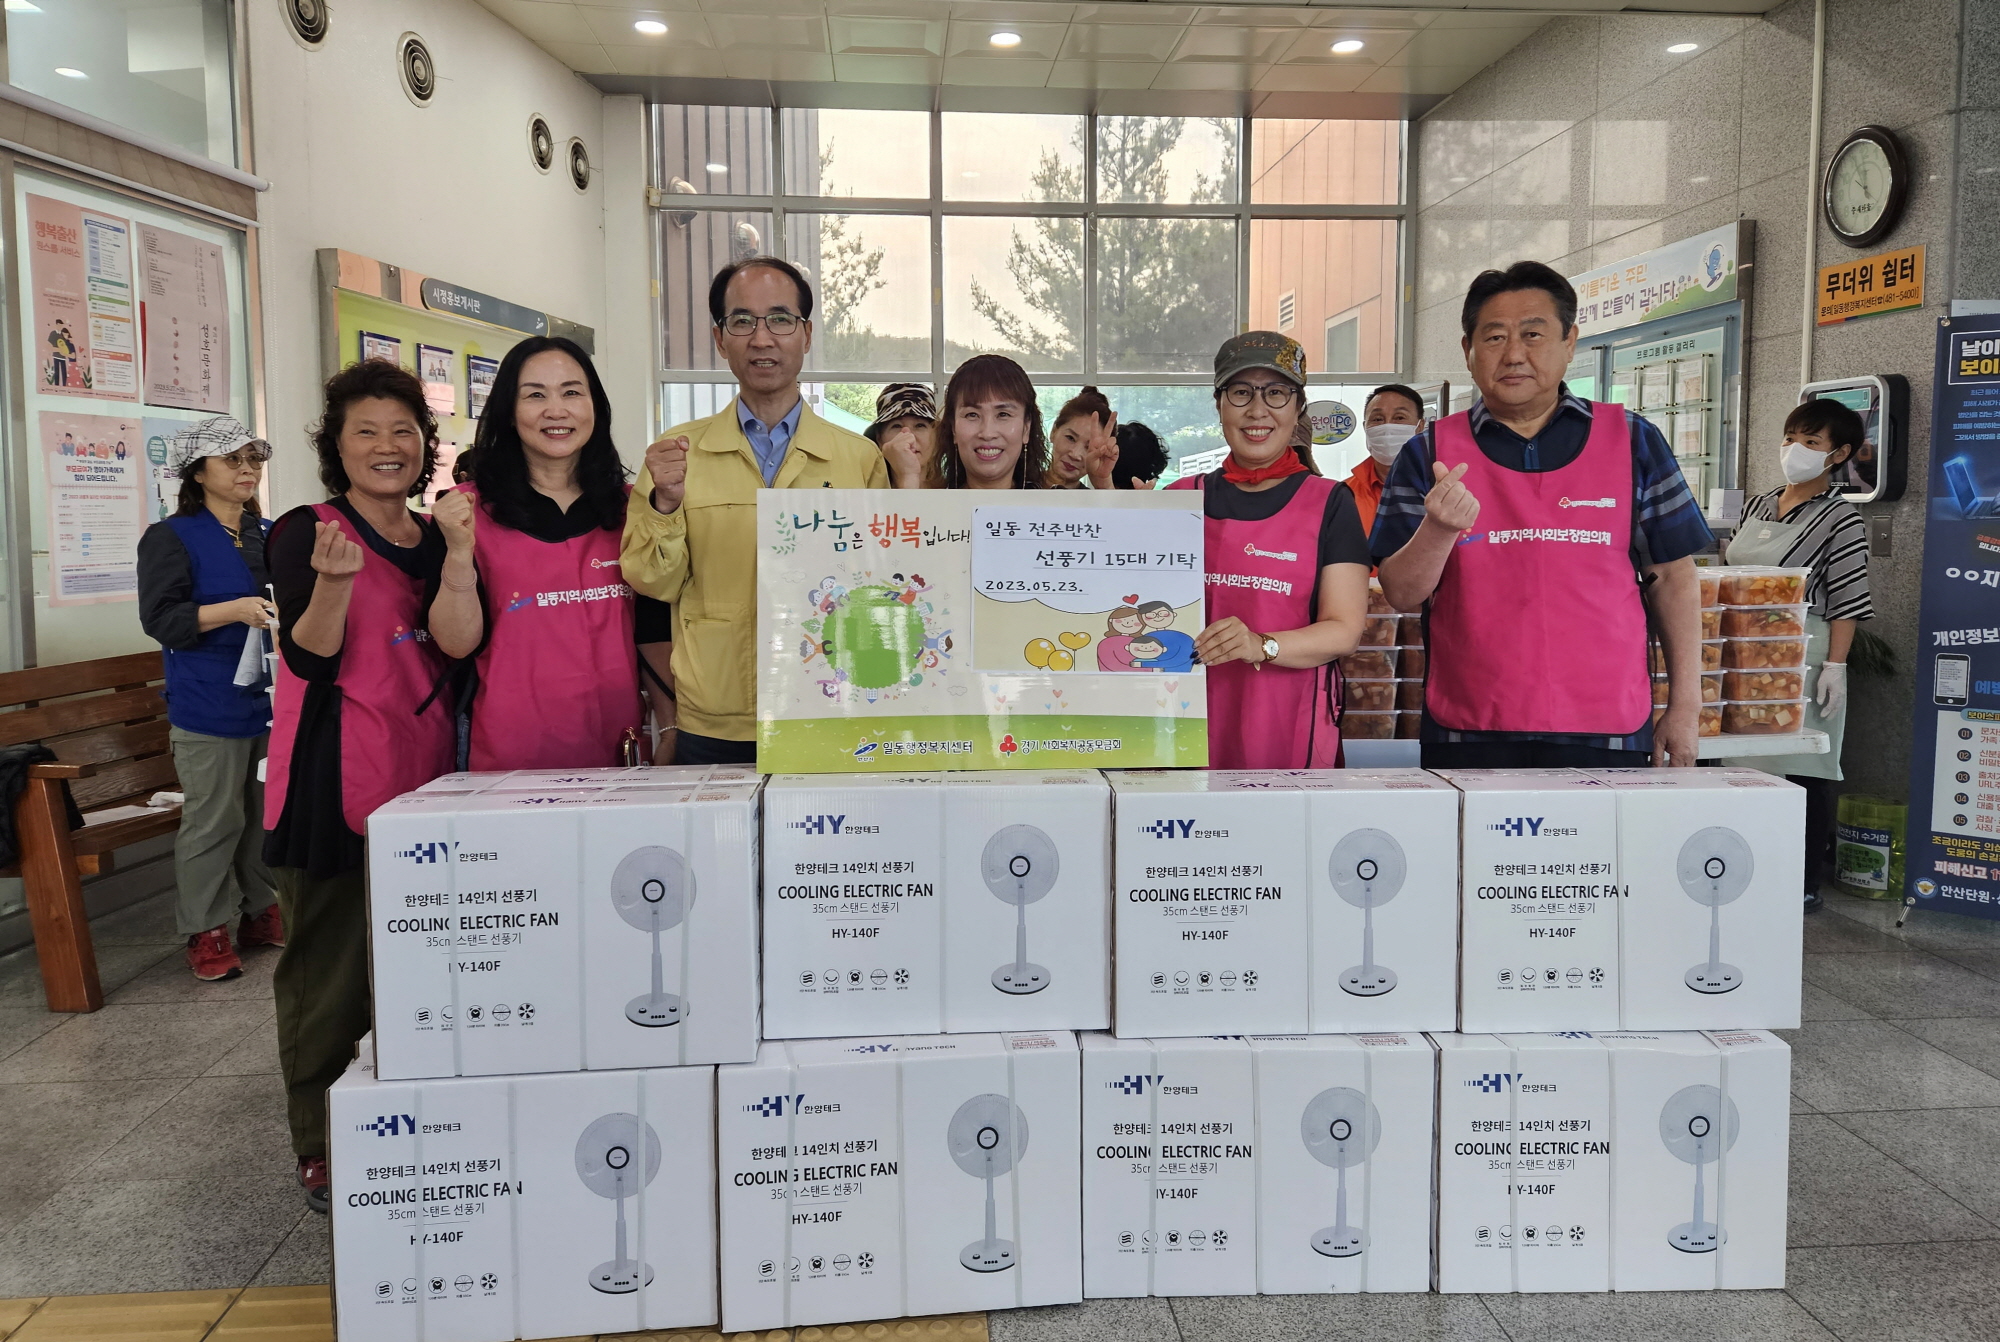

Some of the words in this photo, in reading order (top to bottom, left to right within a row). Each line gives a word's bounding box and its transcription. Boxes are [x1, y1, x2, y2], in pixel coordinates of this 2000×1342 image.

[35, 220, 77, 245] 행복출산
[1580, 272, 1620, 300] 아름다운
[1625, 263, 1648, 286] 주민
[1826, 263, 1873, 300] 무더위
[1882, 254, 1915, 288] 쉼터
[433, 288, 481, 314] 시정홍보게시판
[1579, 303, 1598, 325] 함께
[1602, 292, 1635, 318] 만들어
[793, 509, 864, 552] 나눔은
[868, 513, 971, 548] 행복입니다!
[985, 521, 1021, 537] 일동
[1028, 522, 1102, 538] 전주반찬
[1488, 528, 1612, 545] 일동지역사회보장협의체
[1035, 550, 1095, 568] 선풍기
[1104, 553, 1147, 566] 15대
[1156, 552, 1198, 570] 기탁
[985, 580, 1084, 592] 2023.05.23.
[883, 740, 973, 754] 일동행정복지센터
[1021, 740, 1039, 755] 경기
[1042, 738, 1121, 753] 사회복지공동모금회
[792, 815, 846, 835] HY
[845, 825, 880, 835] 한양테크
[1144, 819, 1196, 839] HY
[1194, 829, 1230, 839] 한양테크
[1493, 817, 1545, 837] HY
[1543, 827, 1578, 837] 한양테크
[1932, 835, 1981, 850] 조금이라도
[459, 851, 499, 863] 한양테크
[1946, 847, 1976, 860] 도움의
[794, 862, 839, 875] 한양테크
[842, 861, 879, 874] 14인치
[881, 860, 915, 874] 선풍기
[1145, 866, 1190, 878] 한양테크
[1192, 865, 1228, 878] 14인치
[1230, 864, 1264, 877] 선풍기
[1493, 864, 1538, 876] 한양테크
[1540, 863, 1576, 876] 14인치
[1578, 863, 1612, 875] 선풍기
[1934, 860, 1988, 880] 피해신고
[457, 890, 498, 905] 14인치
[501, 888, 538, 903] 선풍기
[778, 885, 840, 900] COOLING
[843, 883, 904, 899] ELECTRIC
[907, 883, 934, 898] FAN
[1129, 888, 1190, 903] COOLING
[1193, 887, 1252, 902] ELECTRIC
[1255, 886, 1282, 900] FAN
[1477, 885, 1538, 900] COOLING
[1541, 885, 1600, 899] ELECTRIC
[1603, 885, 1629, 899] FAN
[812, 903, 838, 914] 35cm
[840, 902, 869, 914] 스탠드
[871, 901, 900, 914] 선풍기
[1162, 905, 1188, 916] 35cm
[1190, 905, 1219, 917] 스탠드
[1220, 904, 1249, 916] 선풍기
[1510, 903, 1536, 914] 35cm
[1538, 903, 1566, 914] 스탠드
[1568, 902, 1596, 914] 선풍기
[460, 913, 526, 930] ELECTRIC
[529, 911, 559, 927] FAN
[456, 934, 488, 947] 스탠드
[490, 932, 522, 945] 선풍기
[832, 927, 880, 939] HY-140F
[1182, 930, 1229, 941] HY-140F
[1529, 927, 1576, 939] HY-140F
[448, 960, 501, 973] Y-140F
[1163, 1085, 1199, 1095] 한양테크
[1521, 1083, 1557, 1093] 한양테크
[803, 1103, 841, 1115] 한양테크
[422, 1122, 462, 1134] 한양테크
[1160, 1123, 1197, 1135] 14인치
[1200, 1122, 1233, 1135] 선풍기
[1518, 1120, 1555, 1132] 14인치
[1558, 1119, 1591, 1132] 선풍기
[802, 1142, 840, 1156] 14인치
[843, 1139, 878, 1153] 선풍기
[1097, 1145, 1152, 1160] COOLIN
[1162, 1145, 1222, 1159] ELECTRIC
[1225, 1145, 1252, 1158] FAN
[1520, 1141, 1580, 1155] ELECTRIC
[1583, 1141, 1610, 1154] FAN
[366, 1164, 416, 1180] 한양테크
[464, 1158, 501, 1173] 선풍기
[803, 1164, 867, 1182] ELECTRIC
[870, 1161, 898, 1177] FAN
[1158, 1162, 1187, 1174] 스탠드
[1189, 1162, 1218, 1174] 선풍기
[1516, 1159, 1545, 1171] 스탠드
[1547, 1158, 1576, 1170] 선풍기
[348, 1188, 416, 1208] COOLING
[422, 1183, 489, 1202] ELECTRIC
[800, 1185, 830, 1198] 스탠드
[833, 1182, 863, 1196] 선풍기
[1156, 1188, 1199, 1200] Y-140F
[387, 1208, 416, 1220] 35cm
[453, 1203, 485, 1217] 선풍기
[792, 1211, 842, 1225] HY-140F
